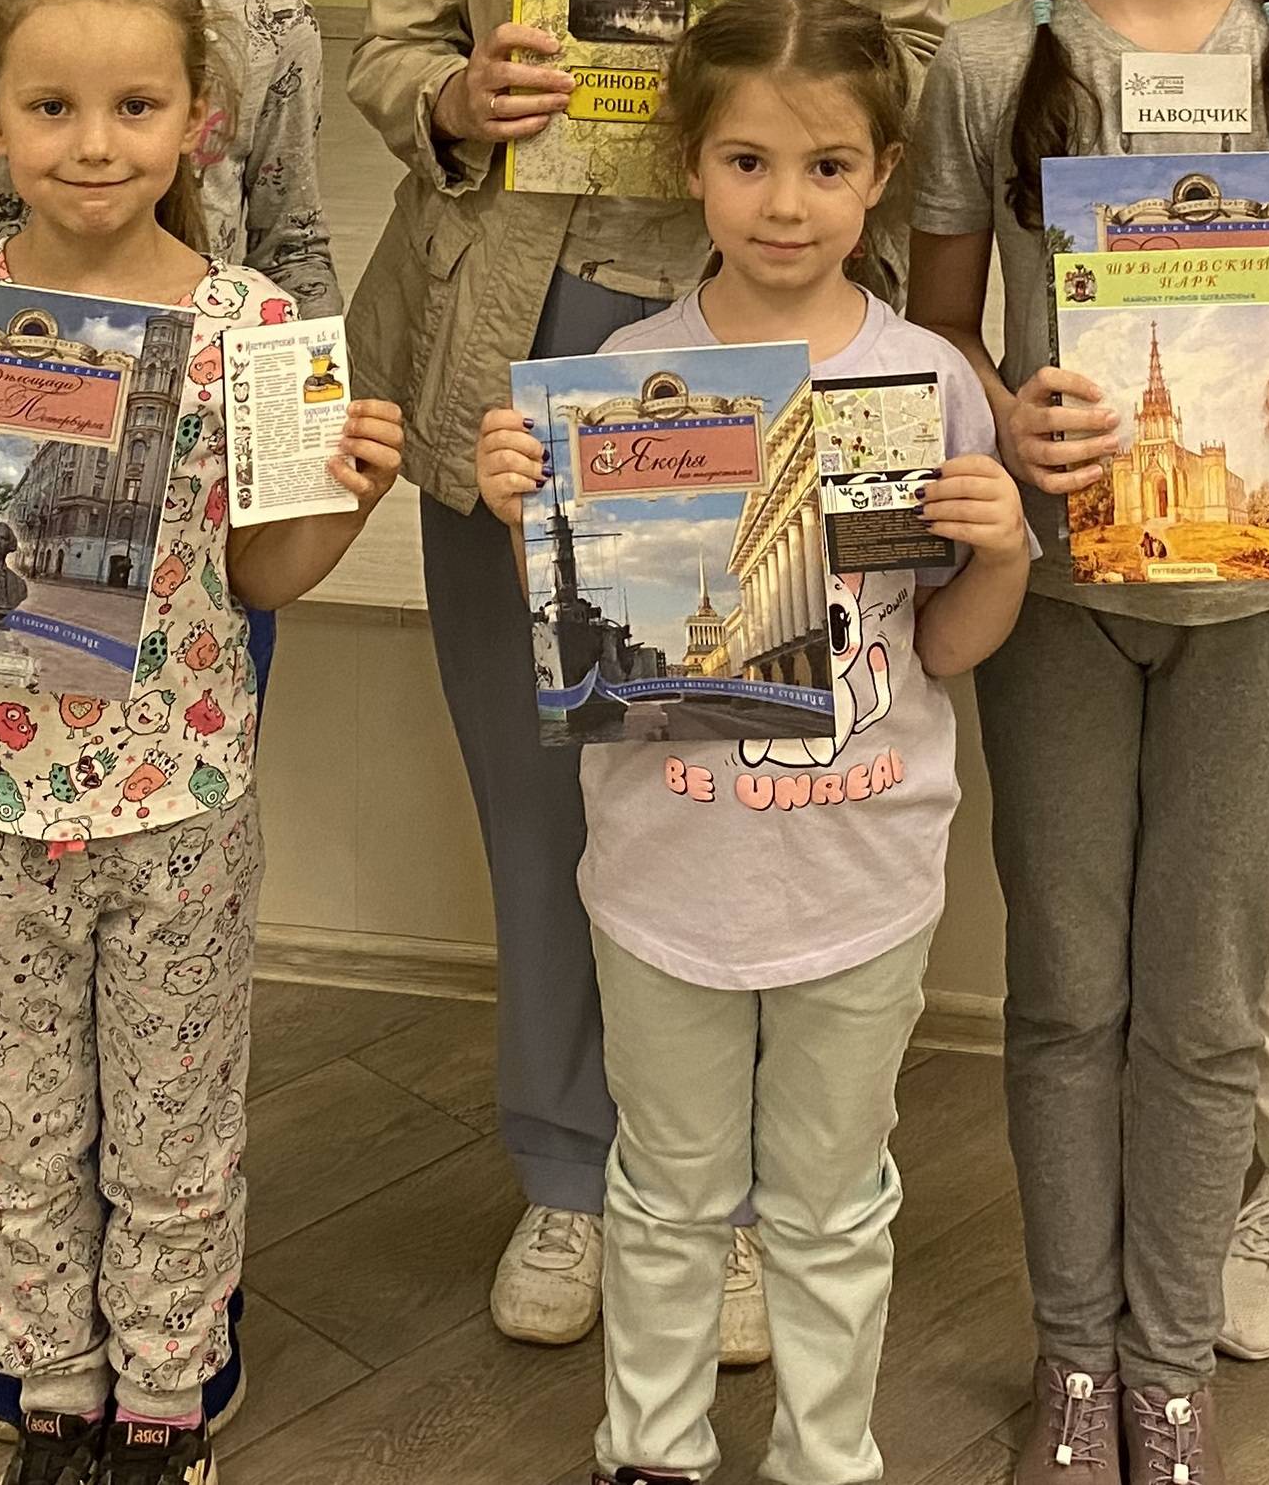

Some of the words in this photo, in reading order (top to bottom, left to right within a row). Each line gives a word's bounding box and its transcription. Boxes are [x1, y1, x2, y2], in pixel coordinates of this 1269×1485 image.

[572, 71, 660, 91] ОСИНОВА
[592, 97, 651, 115] РОЩА
[1138, 107, 1248, 125] НАВОДЧИК
[1159, 275, 1219, 289] ПАРК
[591, 436, 709, 479] Якоря
[664, 754, 716, 803] BE
[133, 1429, 166, 1445] asics
